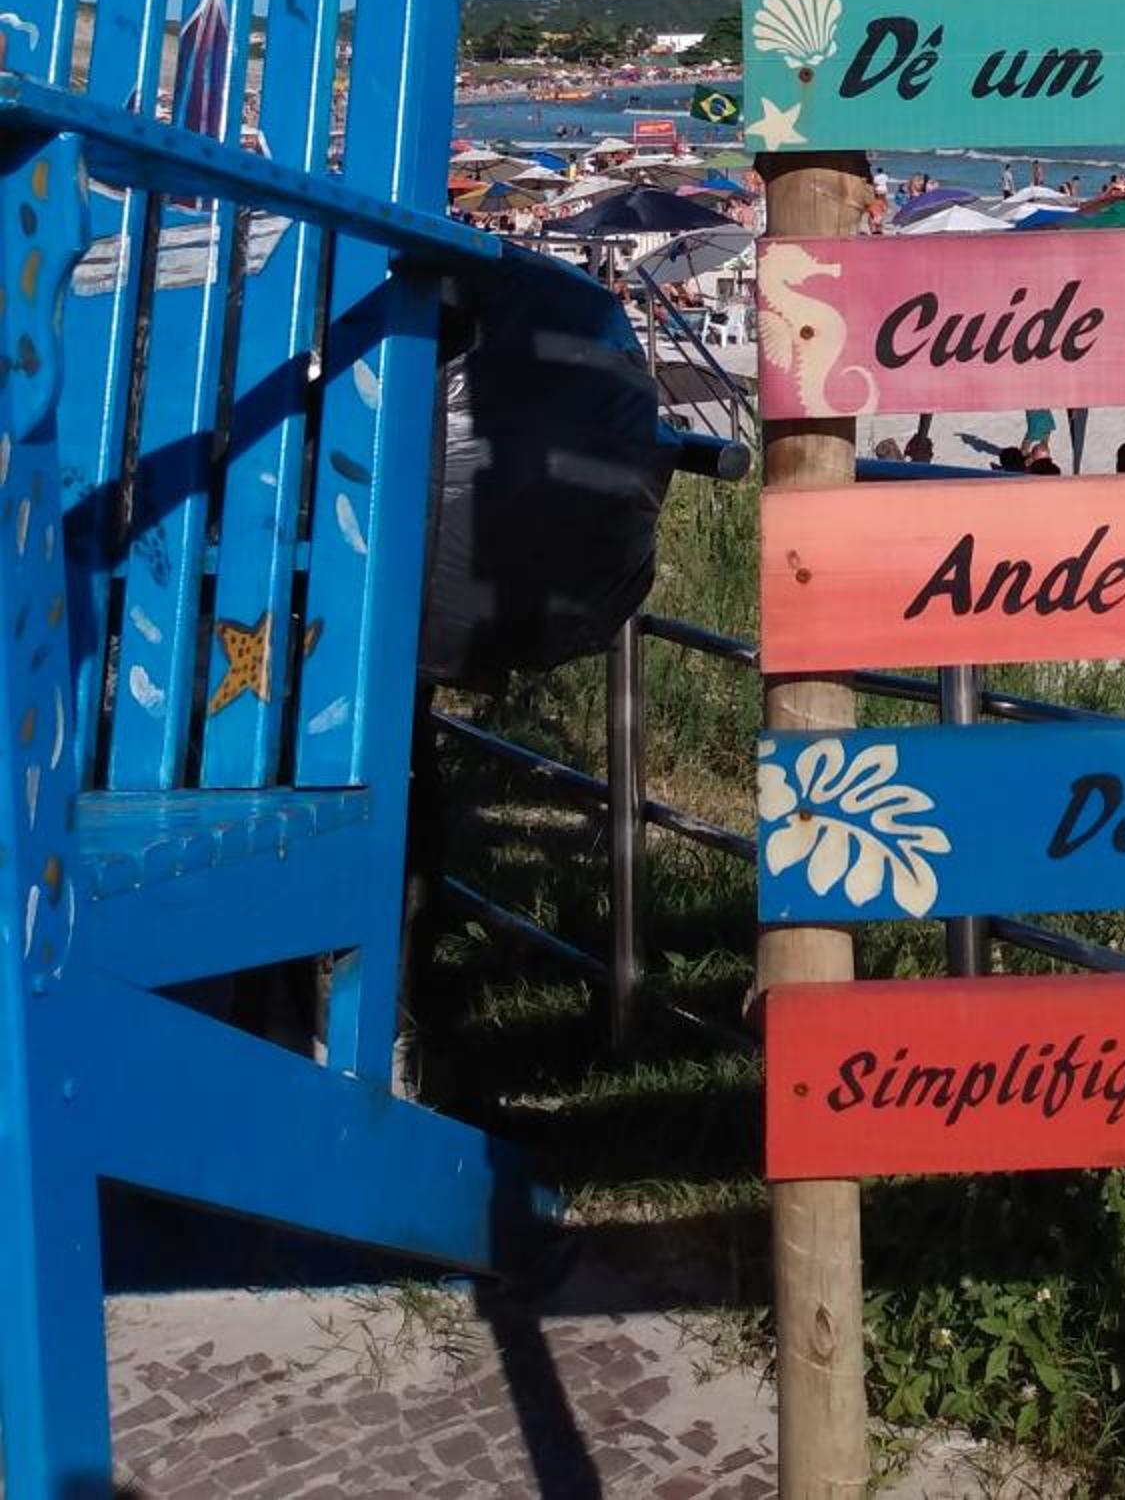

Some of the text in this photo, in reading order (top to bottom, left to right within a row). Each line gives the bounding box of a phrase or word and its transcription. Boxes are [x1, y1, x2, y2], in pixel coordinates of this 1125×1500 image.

[839, 16, 945, 102] Dê
[971, 46, 1104, 100] um
[873, 279, 1106, 370] Cuide
